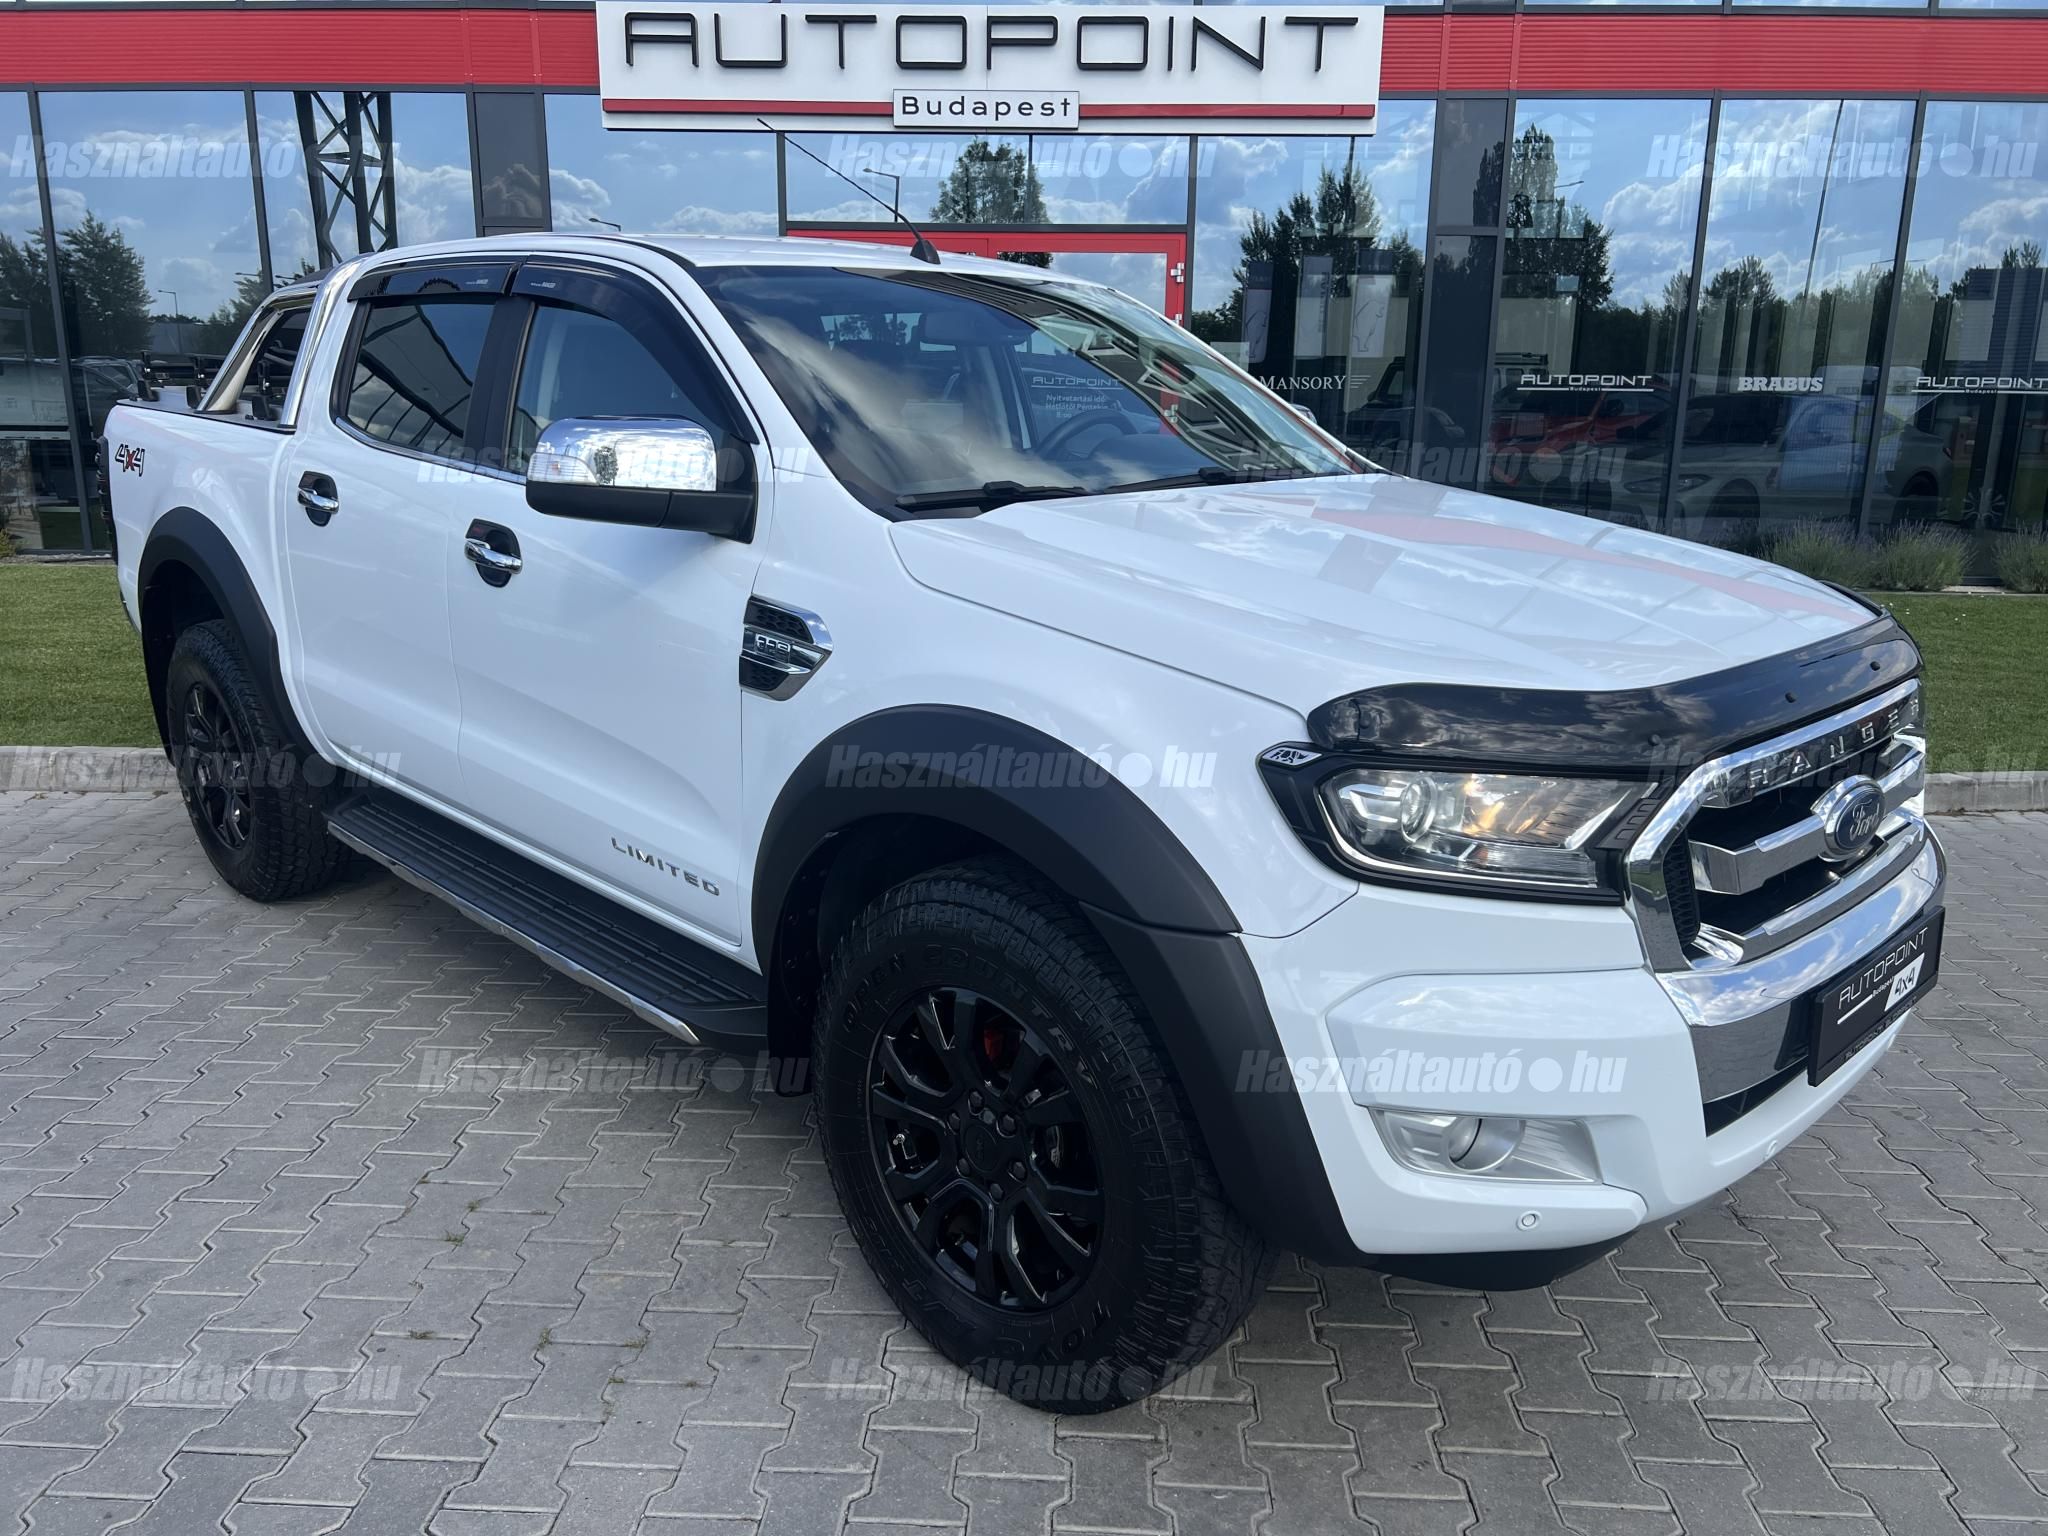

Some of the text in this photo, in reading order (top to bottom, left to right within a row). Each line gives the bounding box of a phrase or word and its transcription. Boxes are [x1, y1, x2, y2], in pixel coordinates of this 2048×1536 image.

[624, 10, 1359, 72] AUTOPOINT
[901, 95, 1073, 122] Budapest
[1032, 376, 1120, 387] AUTOPOINT
[1259, 375, 1346, 390] MANSORY
[1520, 374, 1652, 386] AUTOPOINT
[1737, 377, 1824, 391] BRABUS
[1916, 376, 2048, 388] AUTOPOINT
[1850, 798, 1880, 841] Ford
[611, 837, 720, 896] LIMITED
[1838, 927, 1928, 1009] AUTOPOINT
